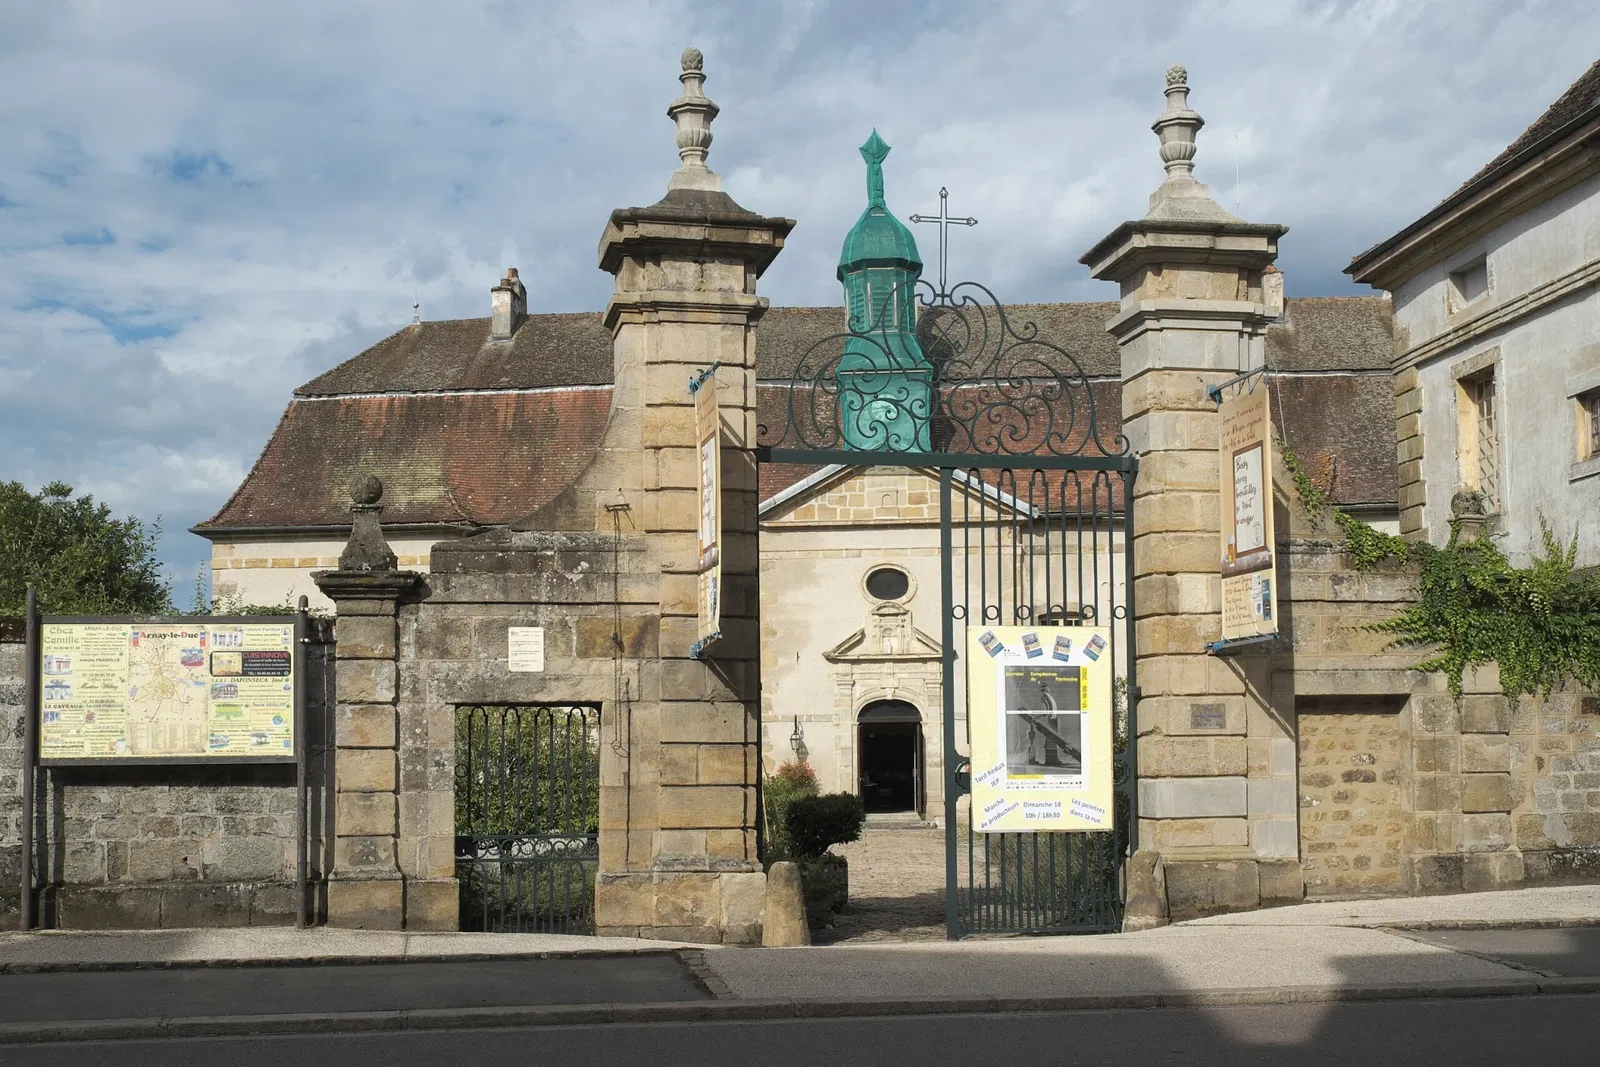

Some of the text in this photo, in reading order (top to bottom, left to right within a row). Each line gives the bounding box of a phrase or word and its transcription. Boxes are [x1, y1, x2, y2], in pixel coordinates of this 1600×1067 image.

[974, 773, 988, 783] Tarif
[990, 778, 1000, 787] JEP
[984, 798, 1005, 813] Marché
[1081, 802, 1106, 814] peintres
[989, 802, 1020, 824] producteurs
[1070, 809, 1083, 818] dans
